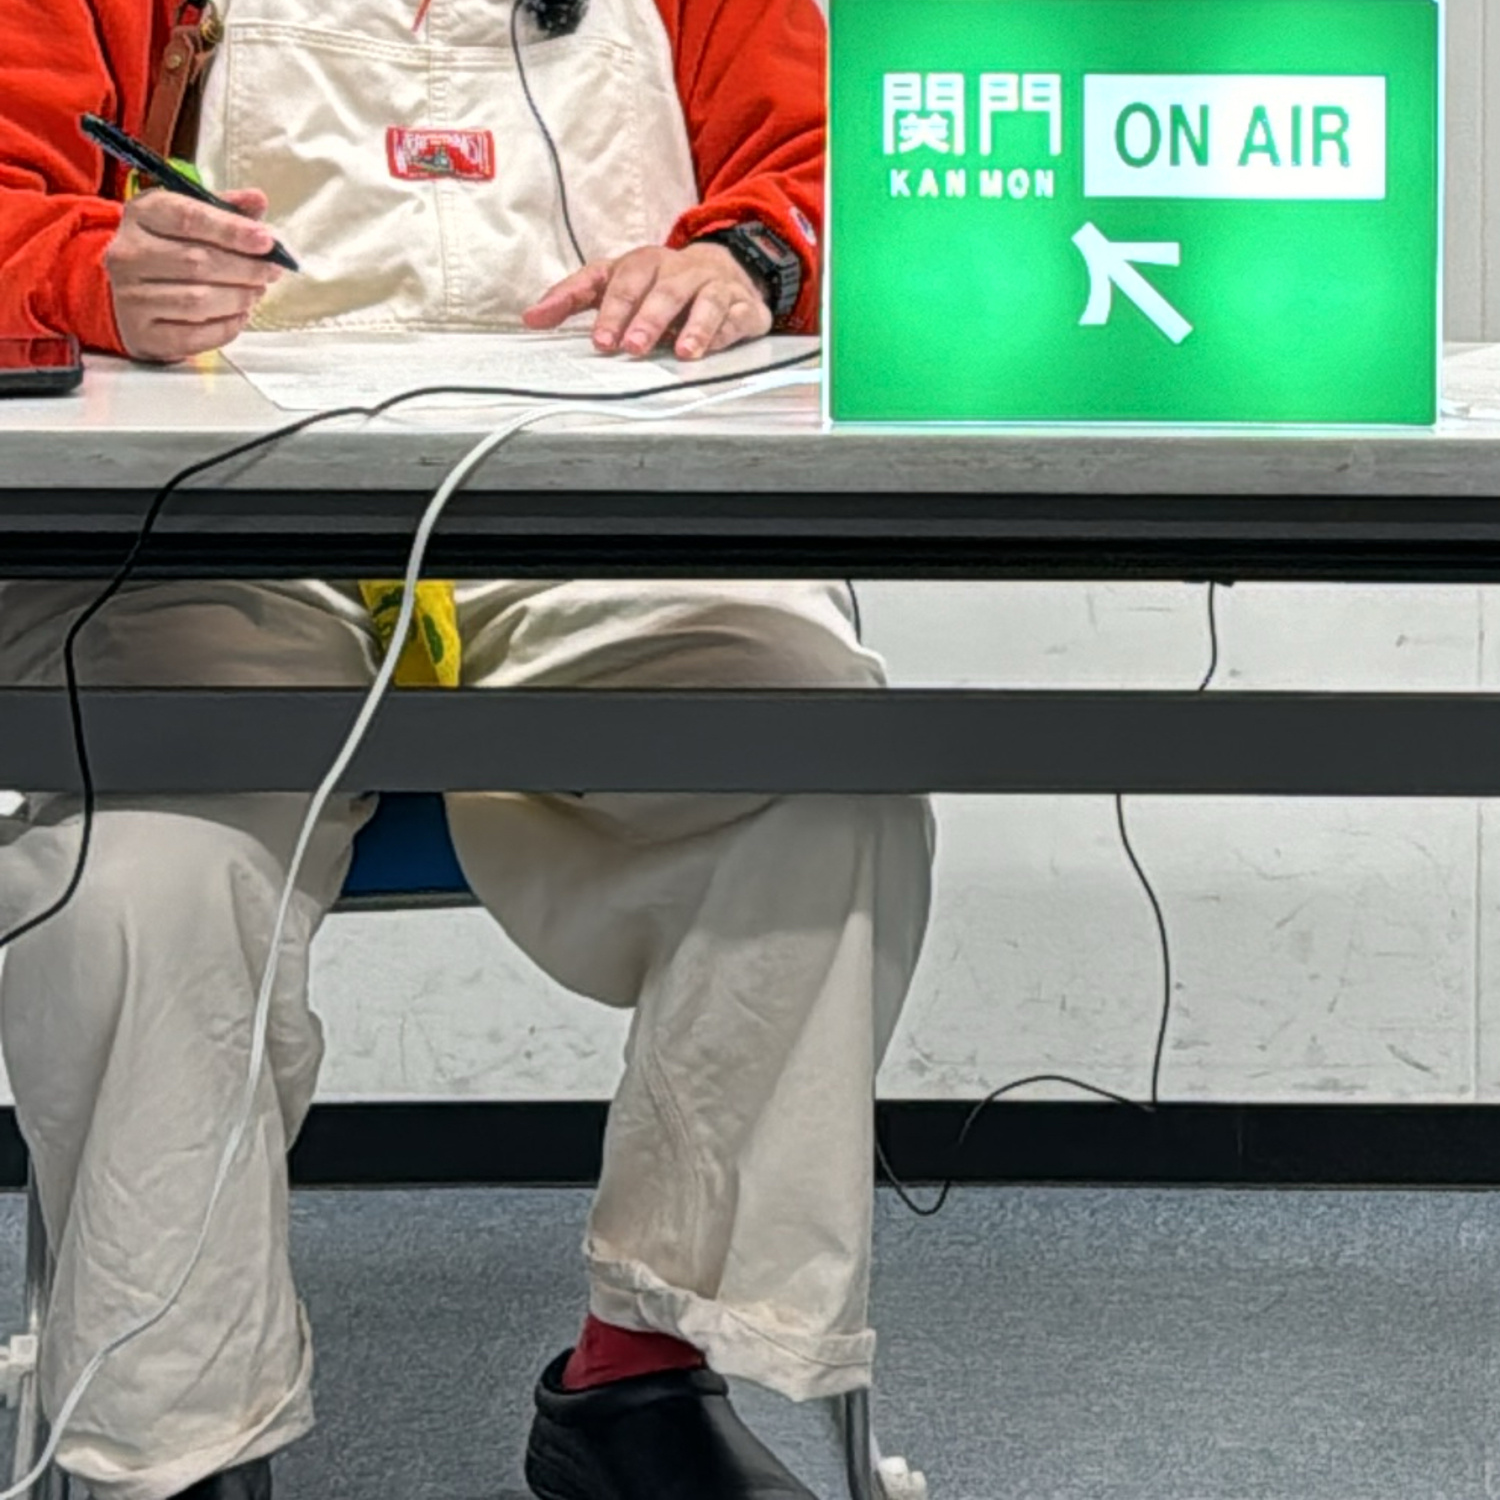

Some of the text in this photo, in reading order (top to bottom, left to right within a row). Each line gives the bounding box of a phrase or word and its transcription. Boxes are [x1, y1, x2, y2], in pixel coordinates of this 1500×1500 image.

[883, 72, 1063, 157] 関門
[1115, 102, 1351, 168] ON AIR
